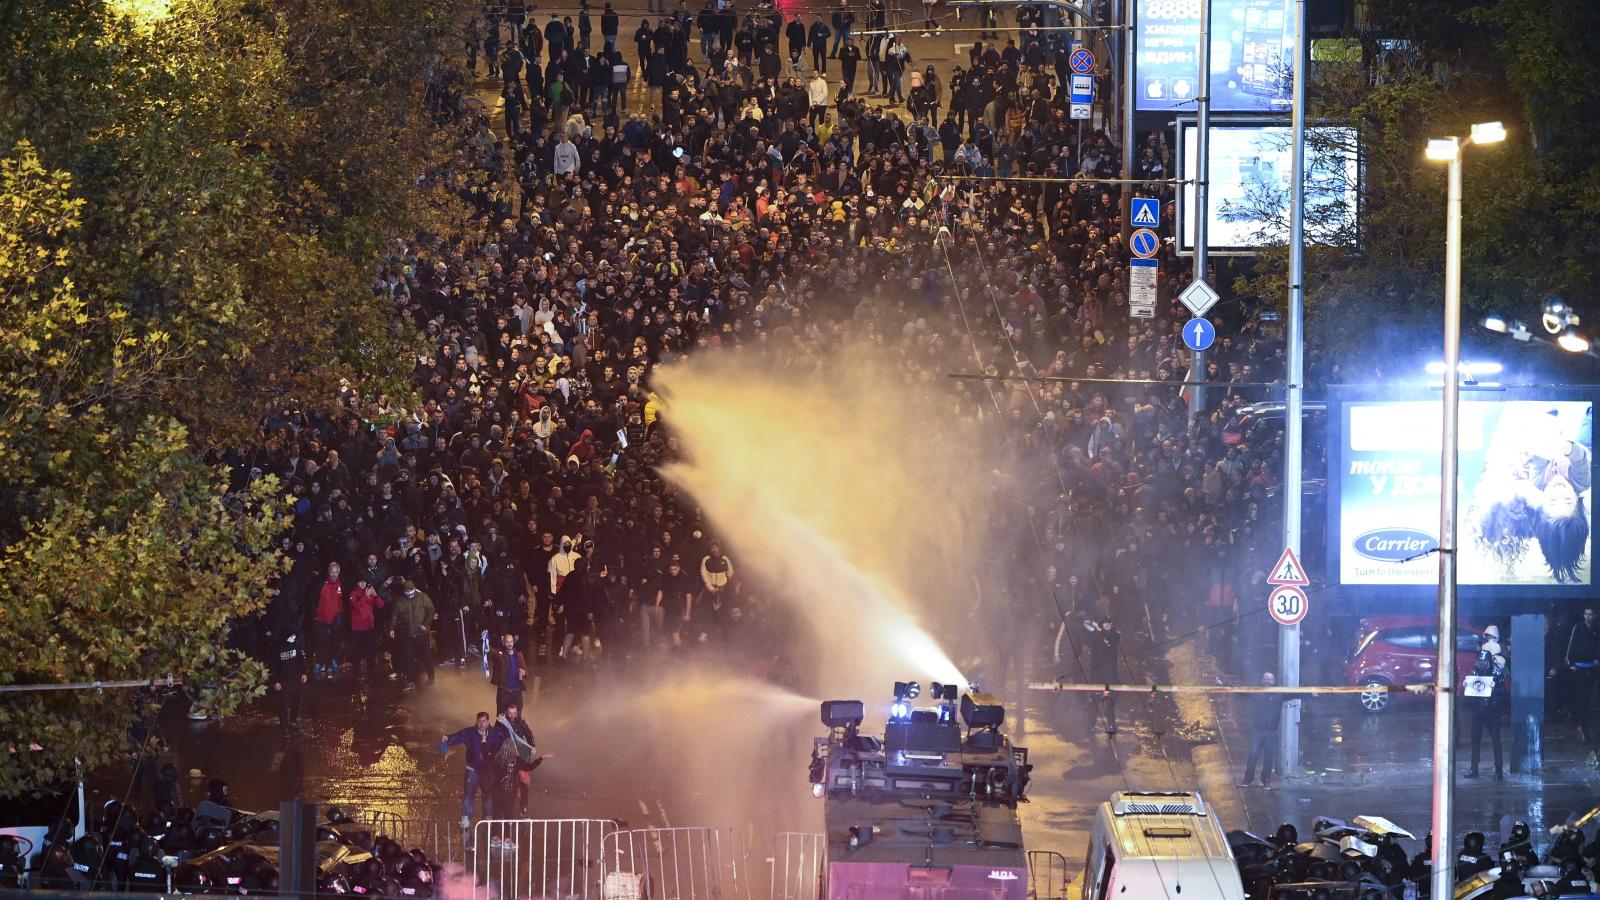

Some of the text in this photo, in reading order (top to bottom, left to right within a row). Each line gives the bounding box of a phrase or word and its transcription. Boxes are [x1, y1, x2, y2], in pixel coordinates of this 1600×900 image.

[1370, 475, 1388, 495] У
[1365, 536, 1430, 552] Carrier
[1354, 568, 1376, 577] Turn
[1277, 595, 1299, 615] 30
